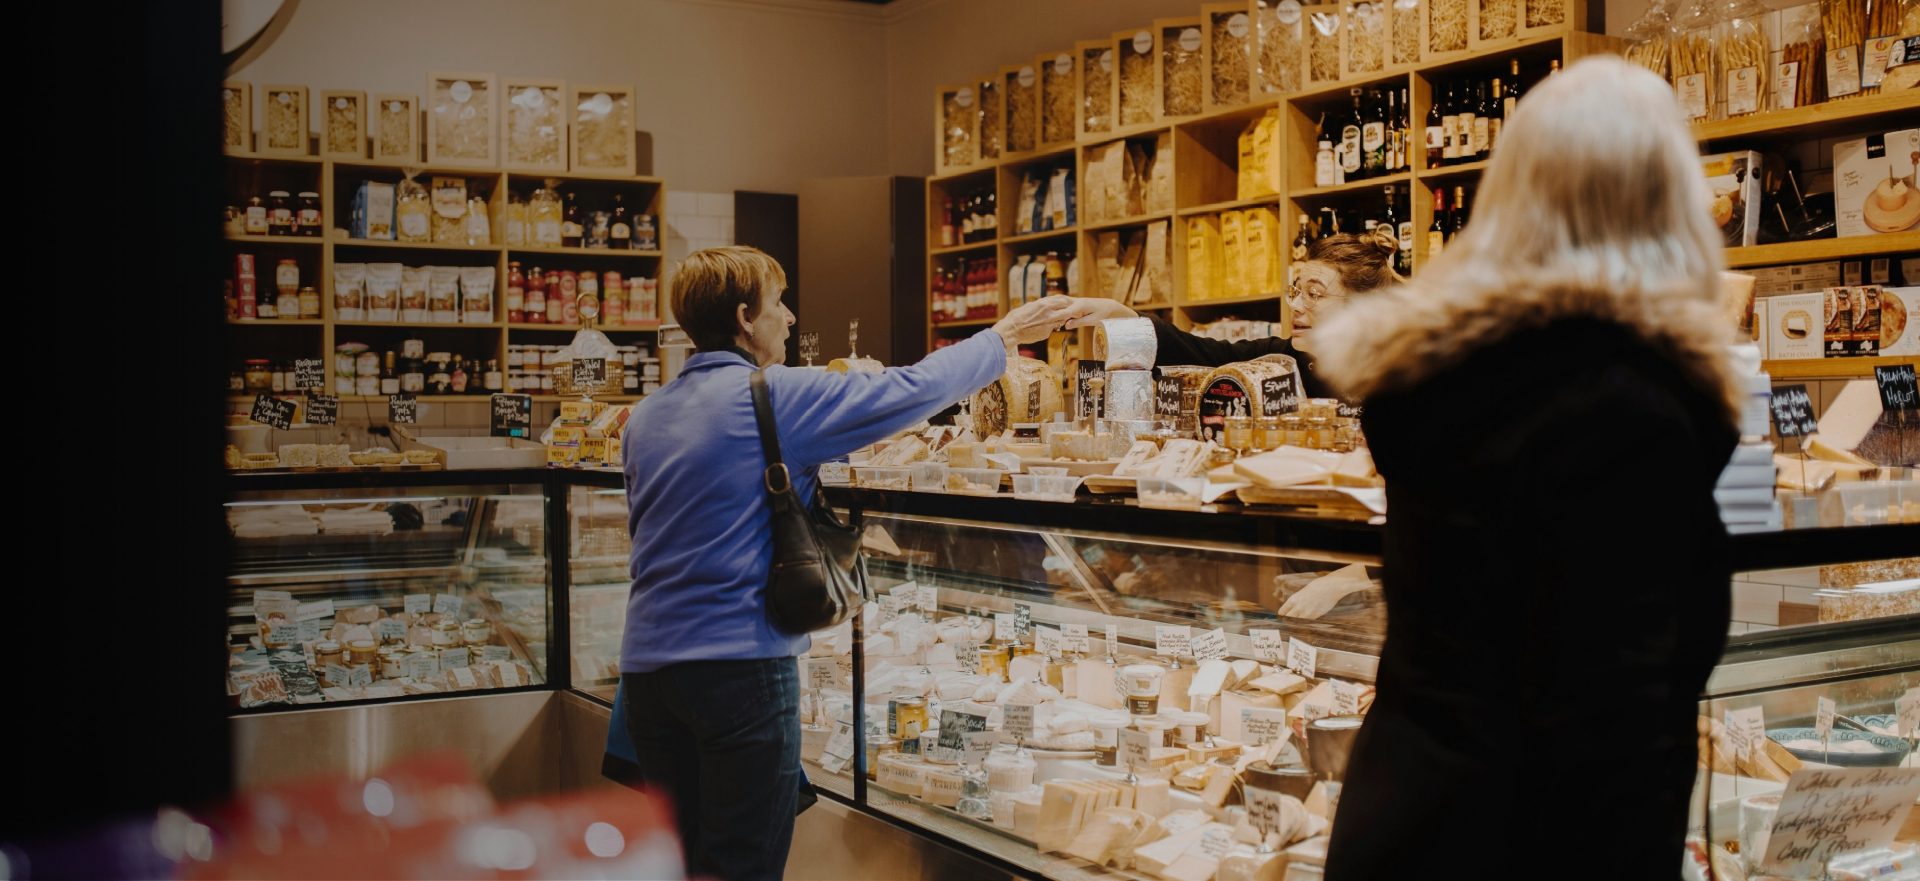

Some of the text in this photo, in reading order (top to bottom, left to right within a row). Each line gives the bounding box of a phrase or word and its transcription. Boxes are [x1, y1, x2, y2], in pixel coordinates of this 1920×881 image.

[1886, 386, 1915, 406] MERLOT
[931, 782, 961, 791] CLARINE
[1806, 821, 1851, 842] TABLES
[1777, 835, 1870, 863] GREAT PRICES
